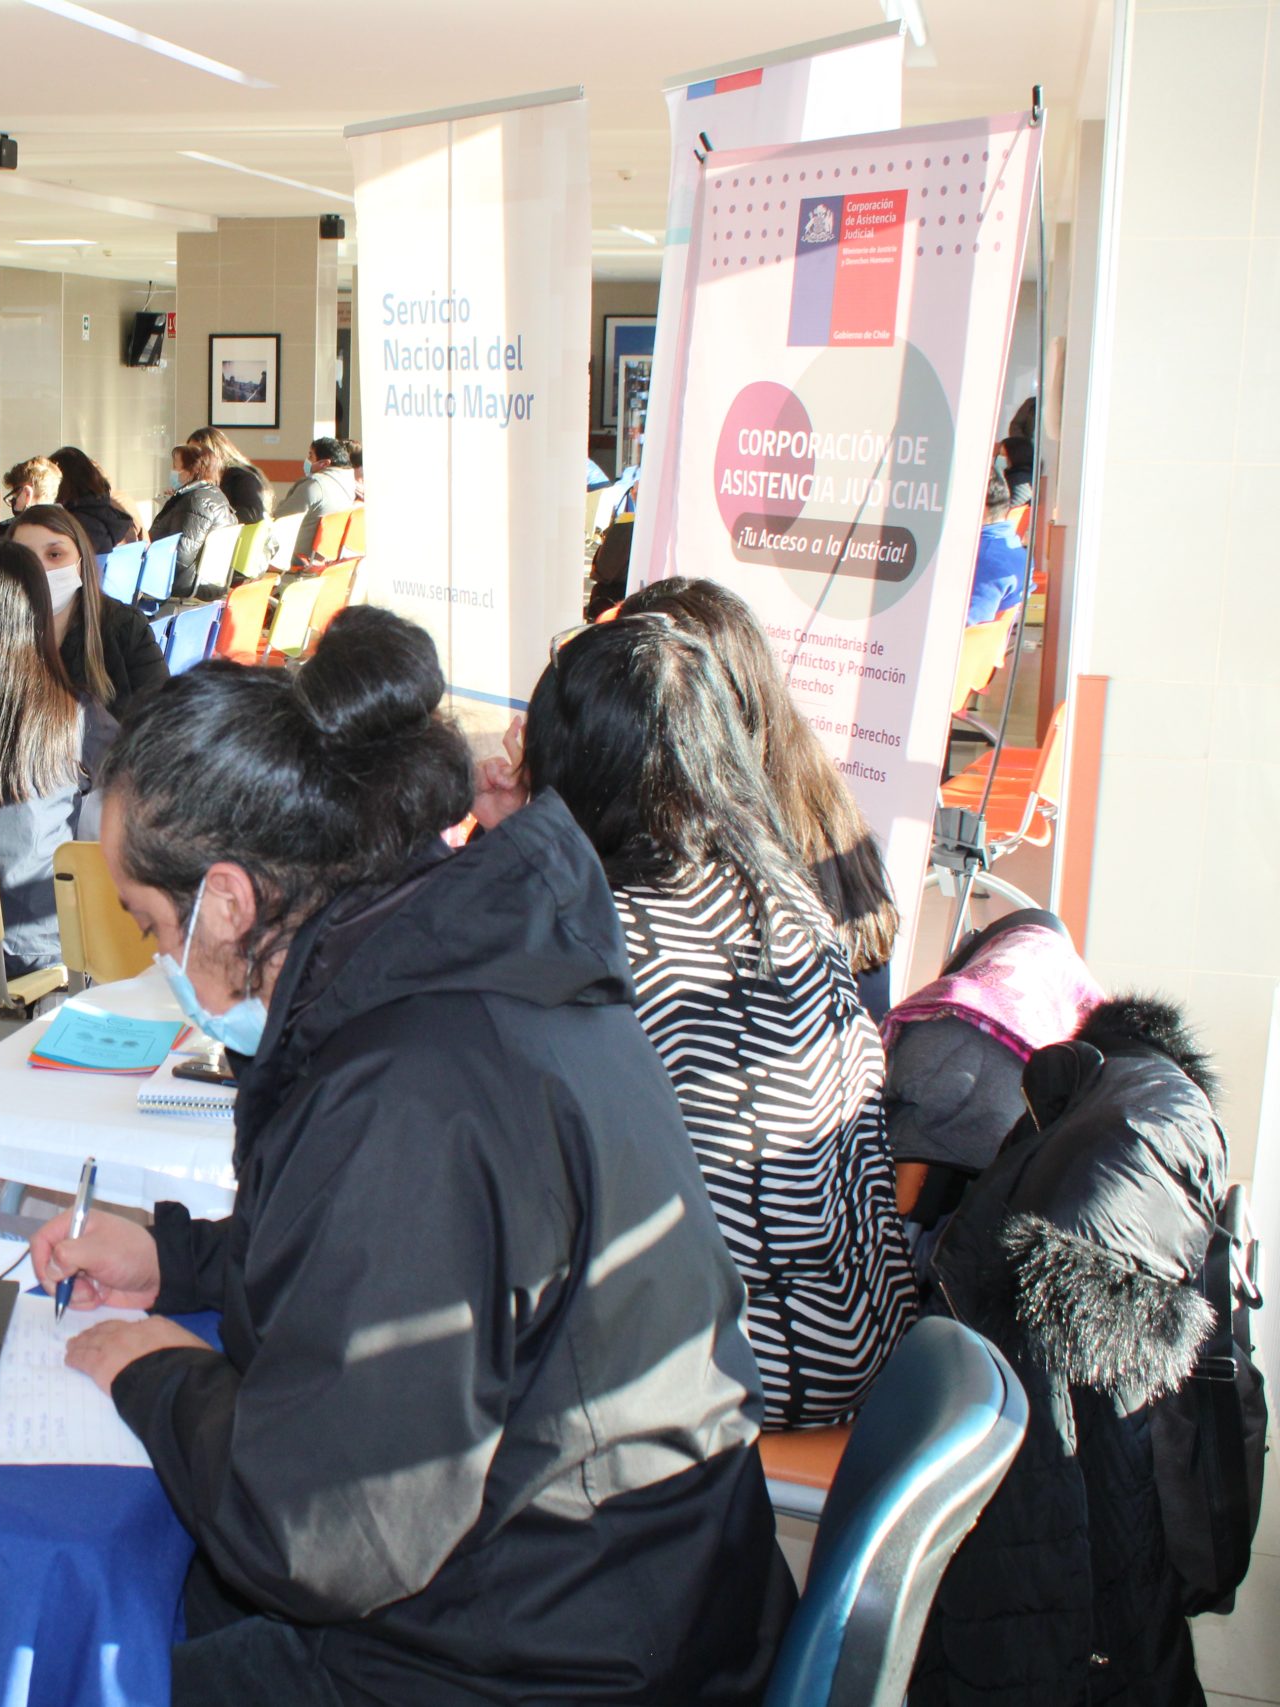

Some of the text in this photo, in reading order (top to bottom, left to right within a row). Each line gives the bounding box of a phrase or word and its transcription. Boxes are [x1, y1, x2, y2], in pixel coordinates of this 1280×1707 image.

[846, 212, 897, 226] de Asistencia
[847, 198, 894, 213] Corporación
[844, 227, 874, 240] Judicial
[382, 289, 471, 326] Servicio
[384, 335, 524, 373] Nacional del
[384, 384, 534, 430] Adulto Mayor
[738, 427, 929, 466] CORPORACIÓN DE
[720, 468, 944, 513] ASISTENCIA JUDICIAL
[737, 526, 908, 564] ¡Tu Acceso a la Justicia!
[392, 579, 494, 609] www.senama.cl
[794, 628, 868, 653] Comunitarias
[870, 640, 884, 656] de
[782, 650, 836, 672] Conflictos
[838, 662, 846, 677] y
[847, 660, 906, 684] Promoción
[785, 672, 835, 695] Derechos
[834, 722, 848, 736] en
[850, 722, 901, 748] Derechos
[832, 756, 887, 783] Conflictos
